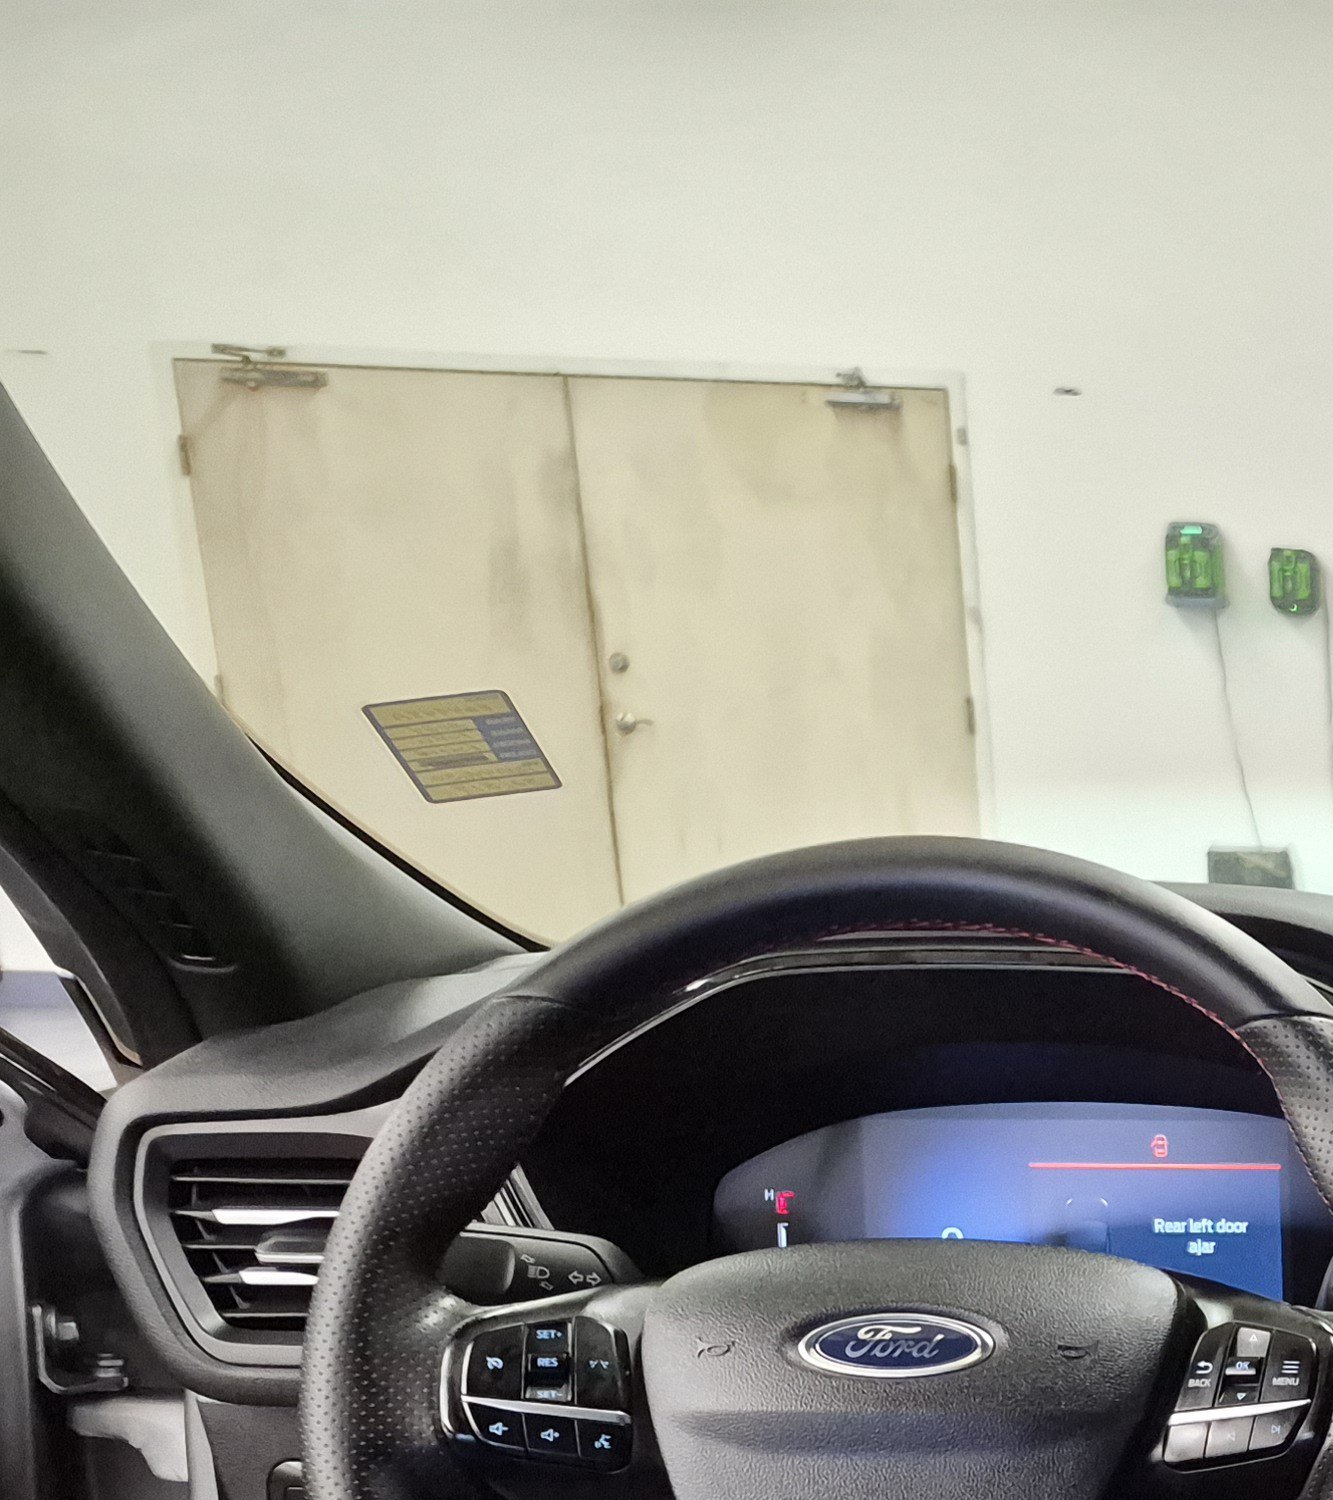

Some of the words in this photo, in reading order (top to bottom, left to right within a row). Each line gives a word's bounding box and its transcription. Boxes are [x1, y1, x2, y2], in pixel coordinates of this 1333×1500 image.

[1153, 1217, 1186, 1236] Rear
[1188, 1217, 1213, 1236] left
[1215, 1217, 1248, 1236] door
[1187, 1238, 1215, 1255] ajar
[536, 1329, 562, 1340] SET+
[844, 1326, 941, 1360] Ford
[537, 1357, 558, 1368] RES
[1235, 1361, 1250, 1370] OK
[1187, 1378, 1212, 1388] BACK
[1272, 1377, 1299, 1386] MENU
